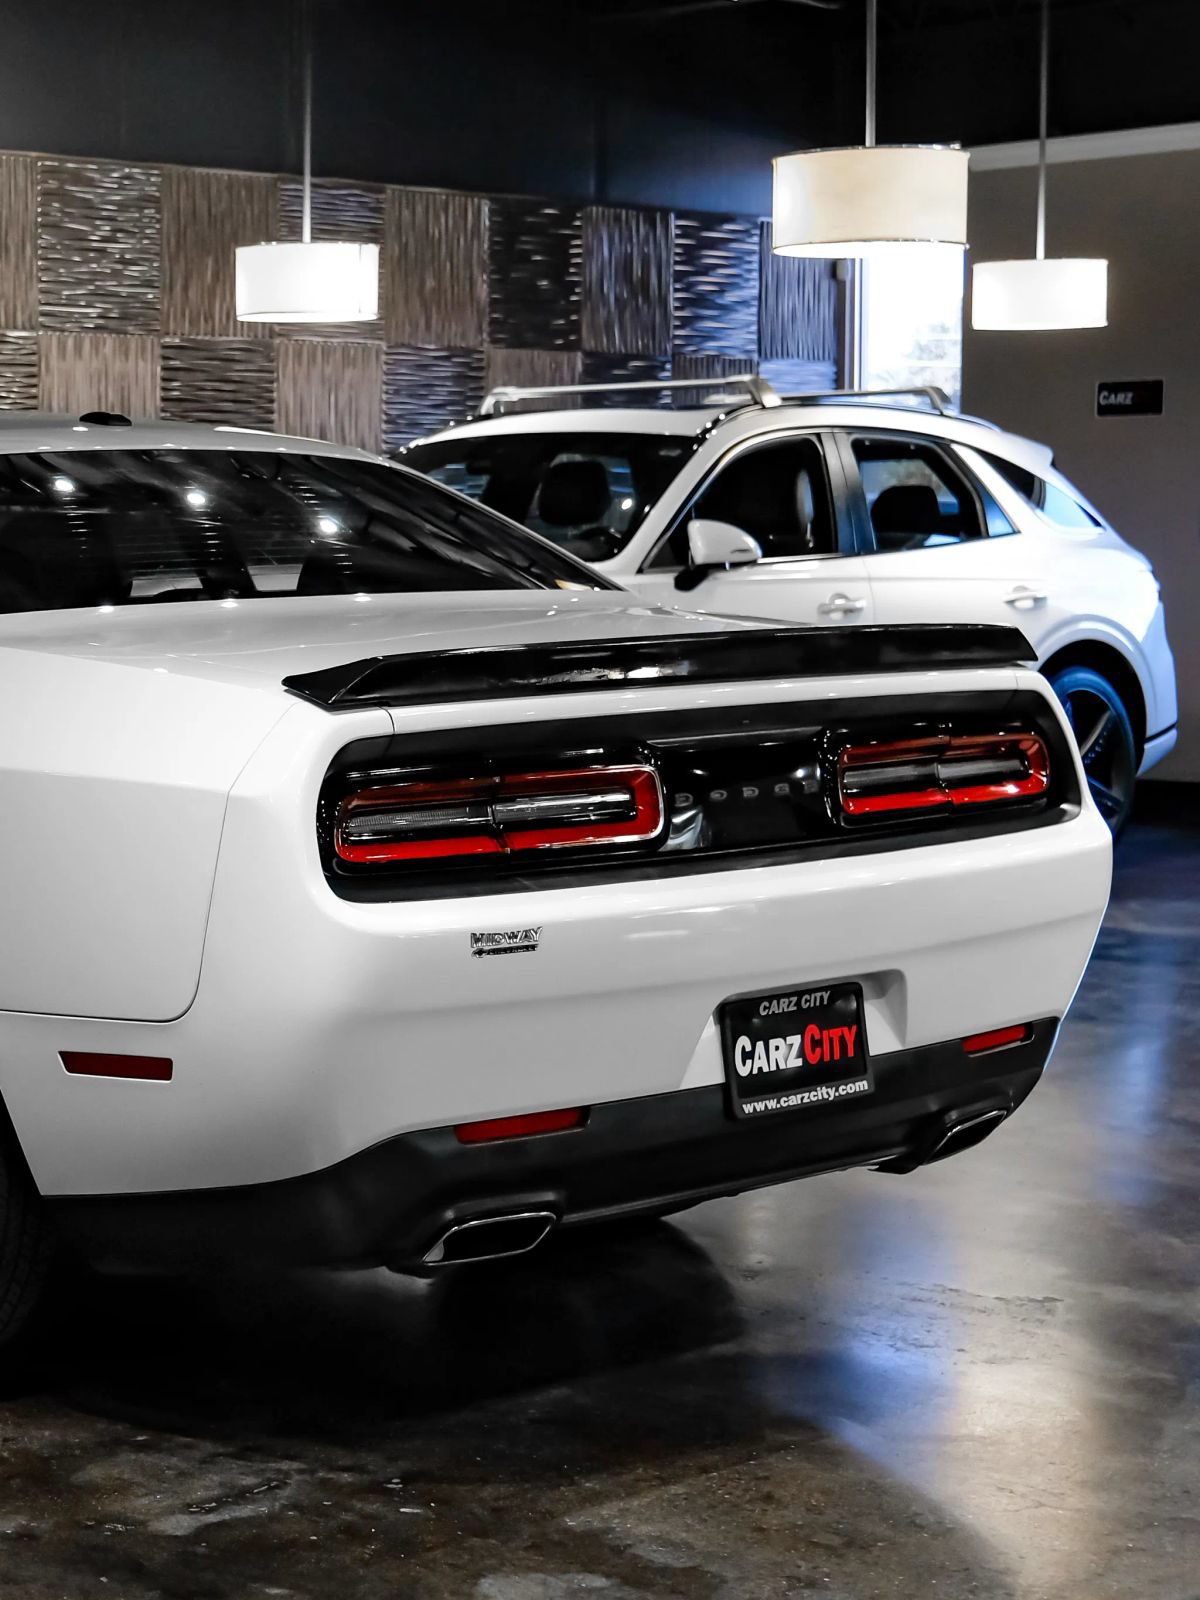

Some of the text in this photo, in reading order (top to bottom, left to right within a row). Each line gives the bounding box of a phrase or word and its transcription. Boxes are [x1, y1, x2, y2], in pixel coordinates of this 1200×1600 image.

[1099, 390, 1134, 405] CARZ
[674, 780, 820, 808] DODGE
[470, 926, 543, 948] MIDWAY
[759, 990, 831, 1016] CARZ CITY
[742, 1079, 869, 1114] www.carzcity.com
